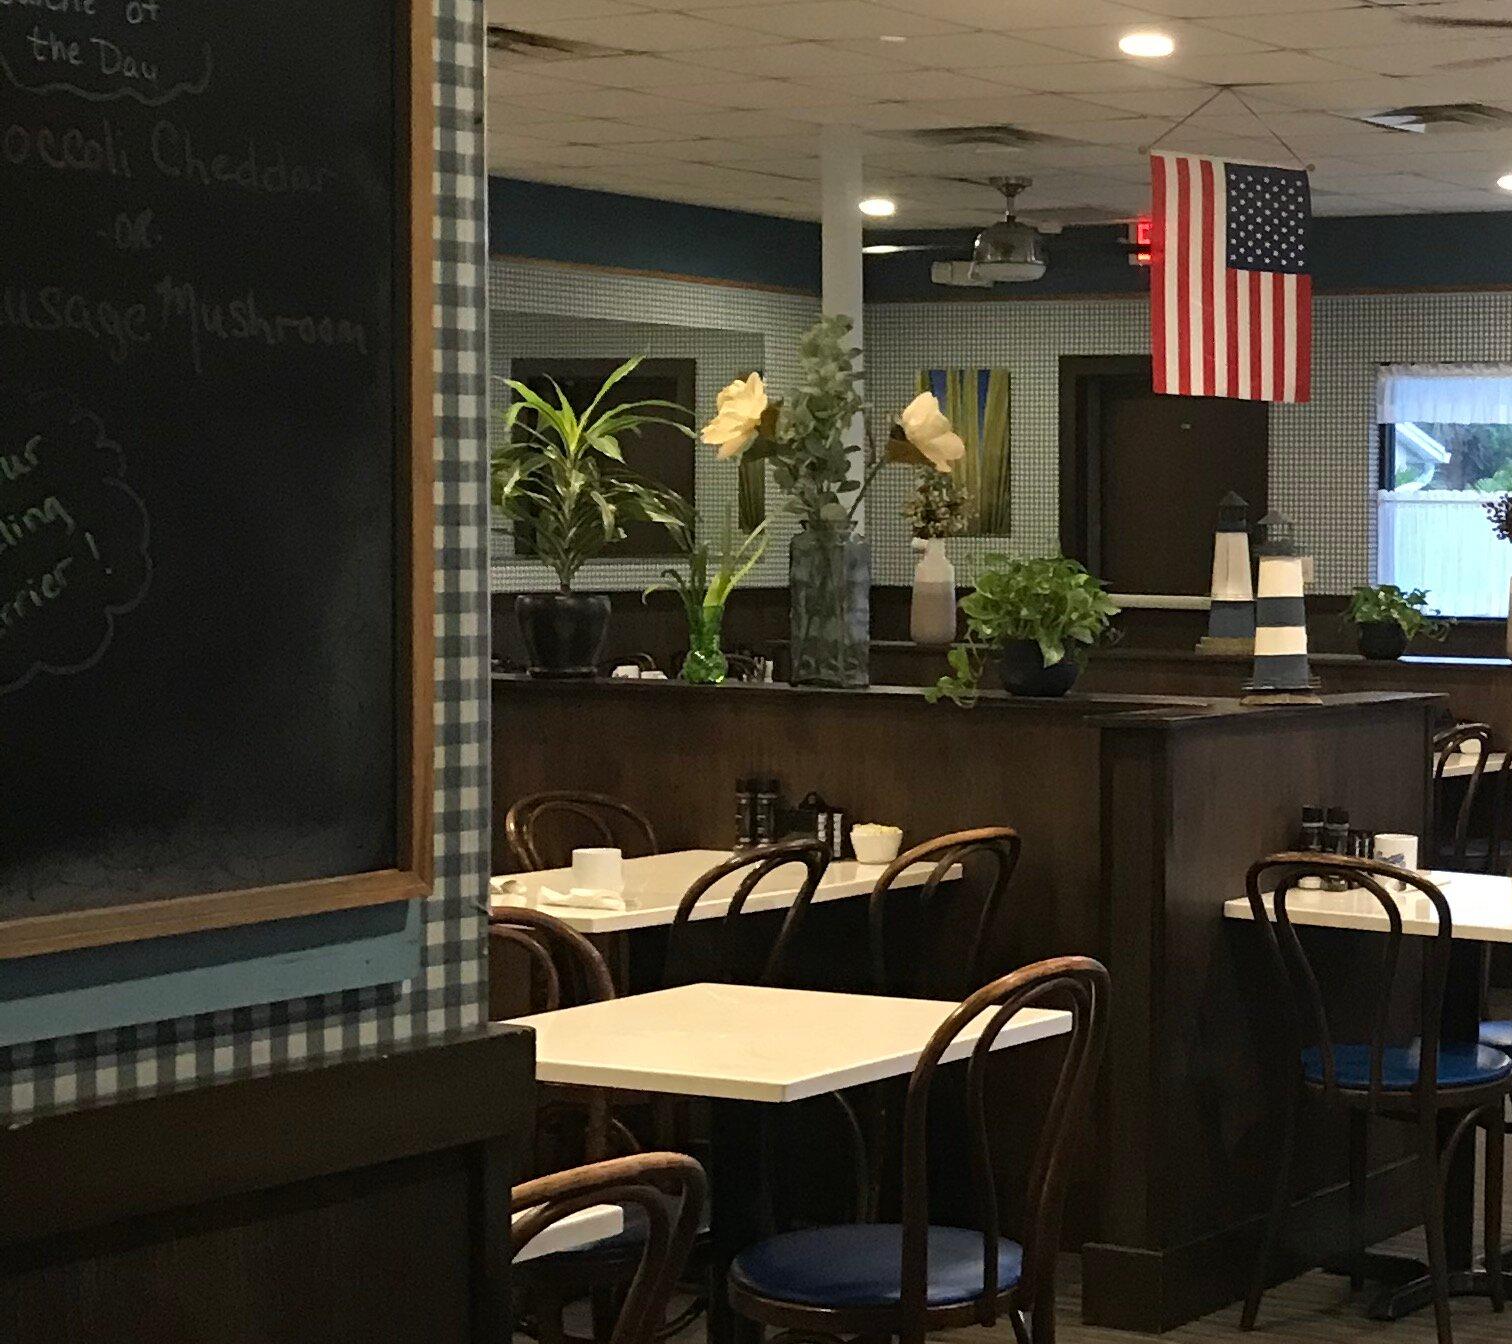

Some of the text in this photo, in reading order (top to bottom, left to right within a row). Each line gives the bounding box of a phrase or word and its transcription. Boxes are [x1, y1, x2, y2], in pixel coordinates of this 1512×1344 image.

[26, 24, 158, 83] the Day
[3, 118, 338, 194] occoli Cheddar
[0, 273, 369, 375] usage Mushroom
